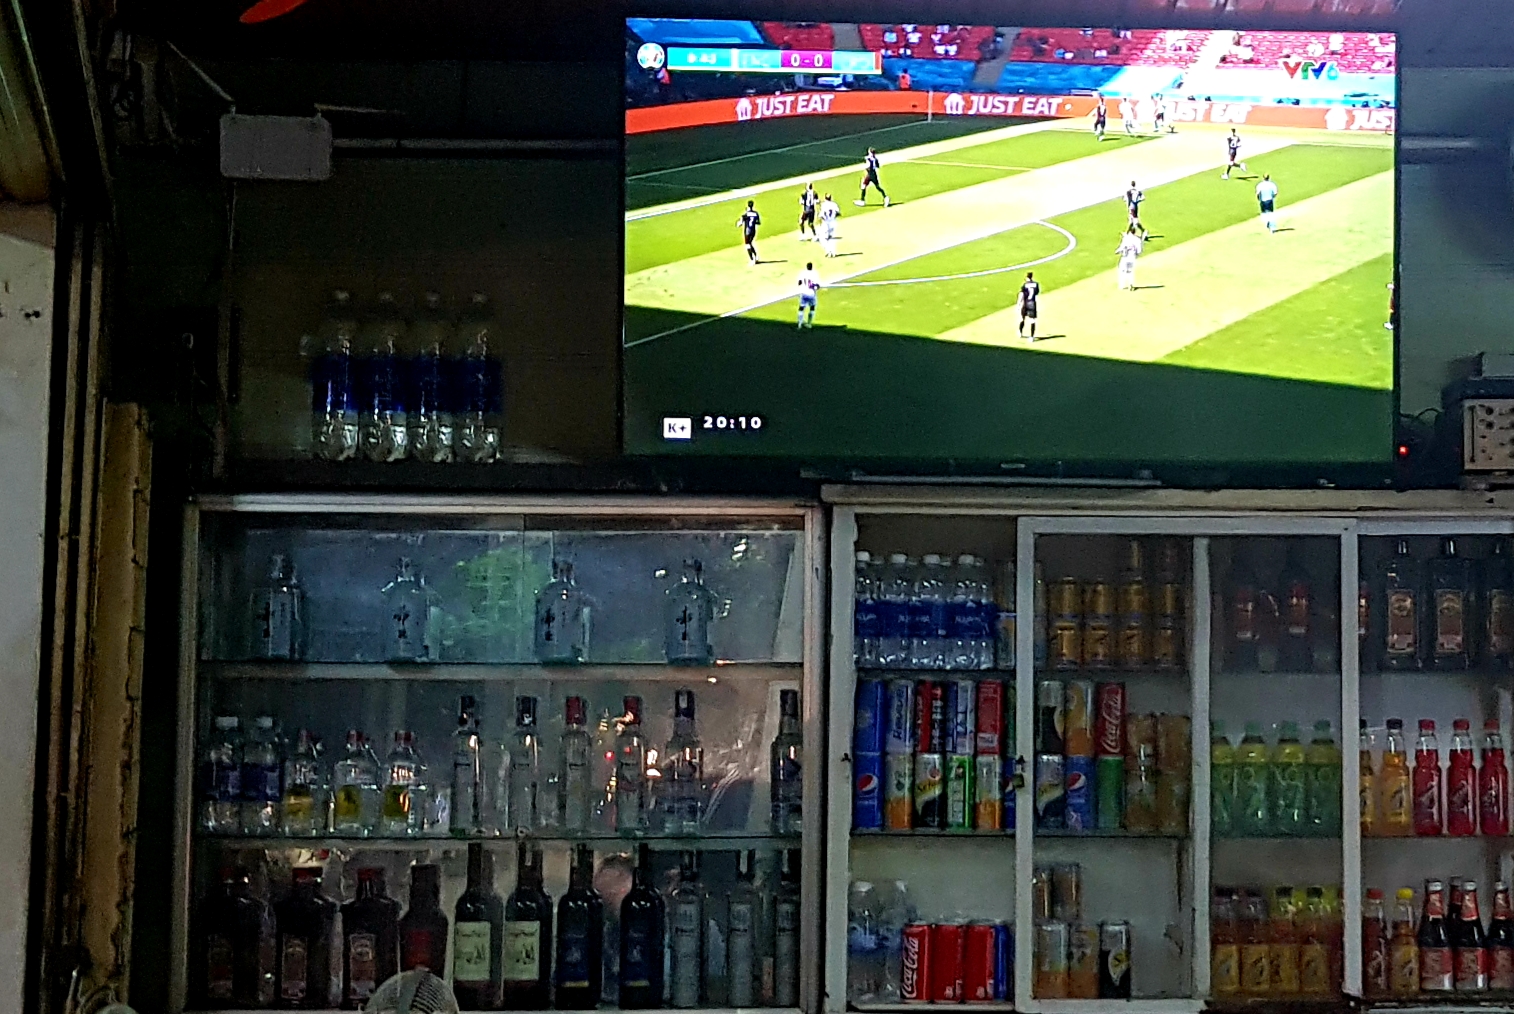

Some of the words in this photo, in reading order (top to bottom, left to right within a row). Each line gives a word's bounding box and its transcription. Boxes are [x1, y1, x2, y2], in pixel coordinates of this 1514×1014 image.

[790, 53, 800, 67] 0
[814, 53, 824, 67] 0
[1282, 61, 1339, 80] VTV6
[755, 95, 795, 119] JUST
[797, 93, 835, 113] EAT
[968, 95, 1021, 115] JUST
[1022, 97, 1063, 116] EAT
[1165, 101, 1213, 122] UST
[1210, 103, 1254, 124] EAT
[668, 423, 687, 434] K+
[703, 416, 762, 430] 20:10
